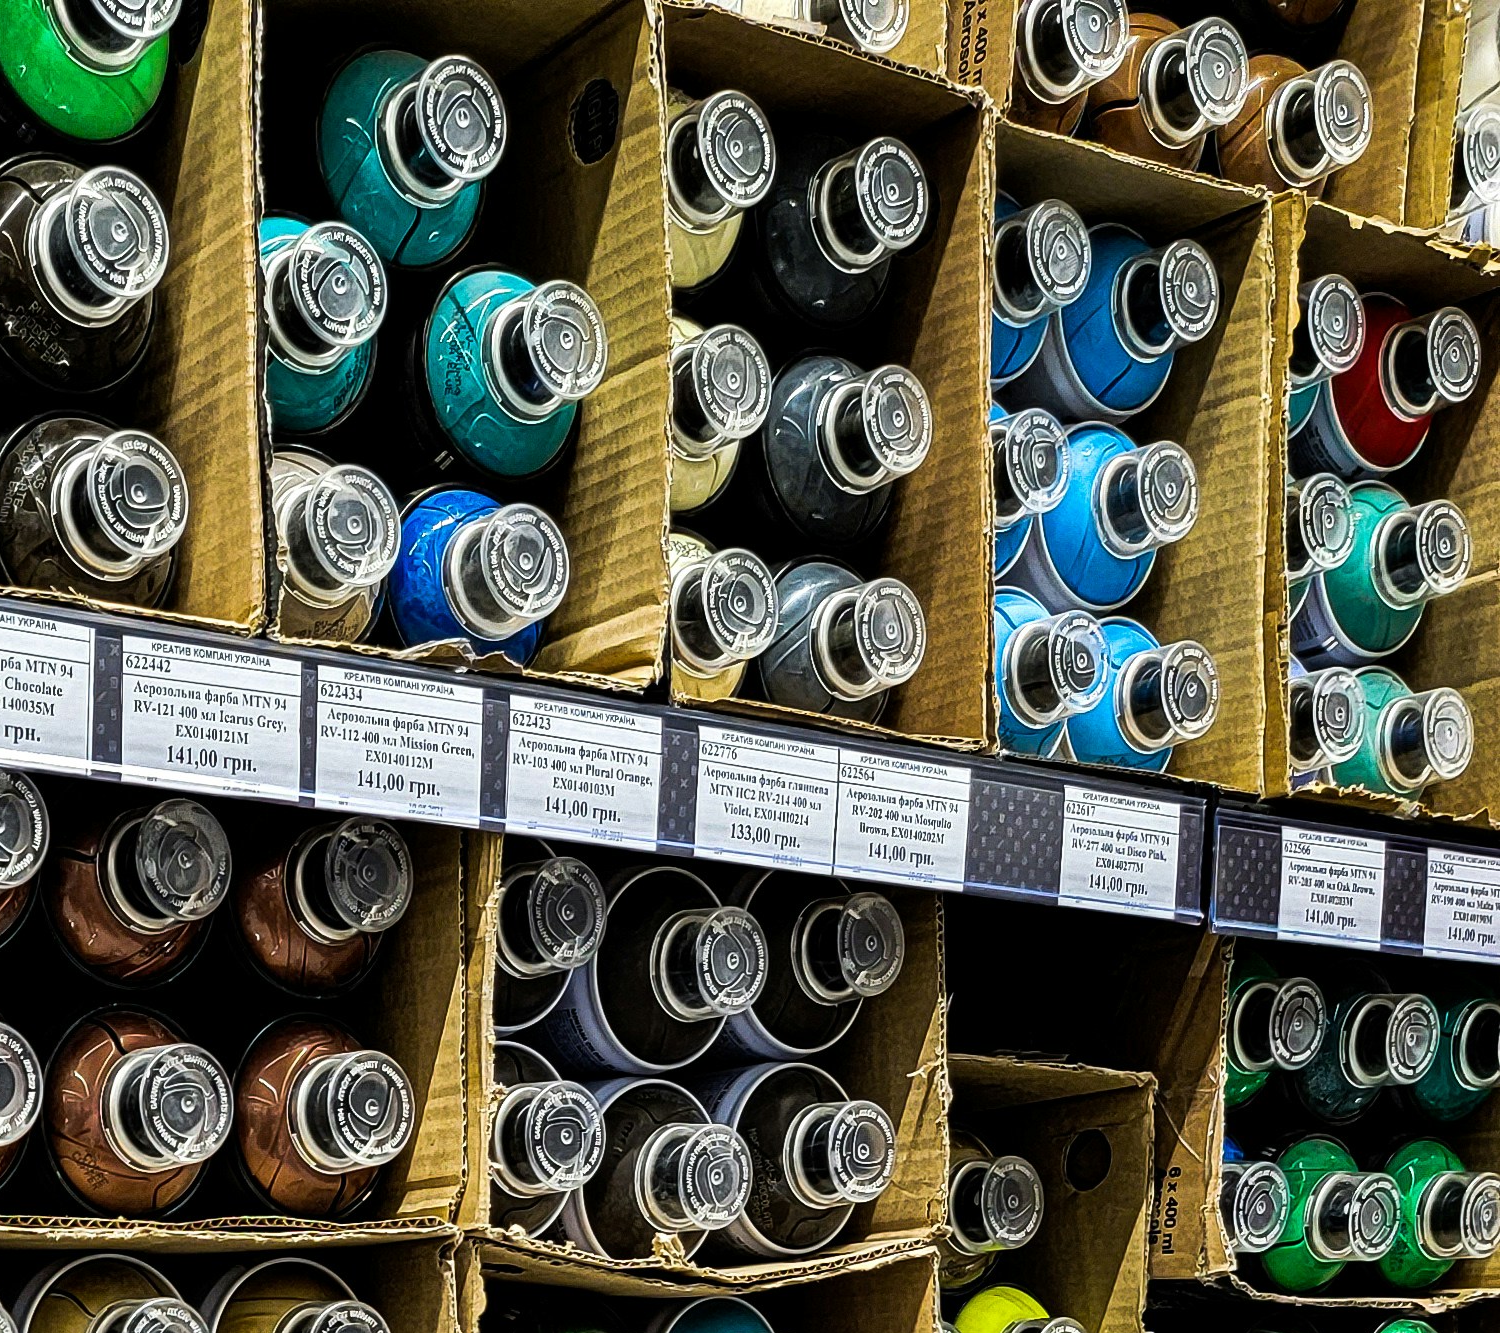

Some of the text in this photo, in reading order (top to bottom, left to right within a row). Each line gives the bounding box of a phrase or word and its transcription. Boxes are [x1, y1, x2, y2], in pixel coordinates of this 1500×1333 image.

[125, 654, 171, 673] 622442
[4, 724, 41, 745] грн.
[166, 745, 257, 776] 141,00 грн.
